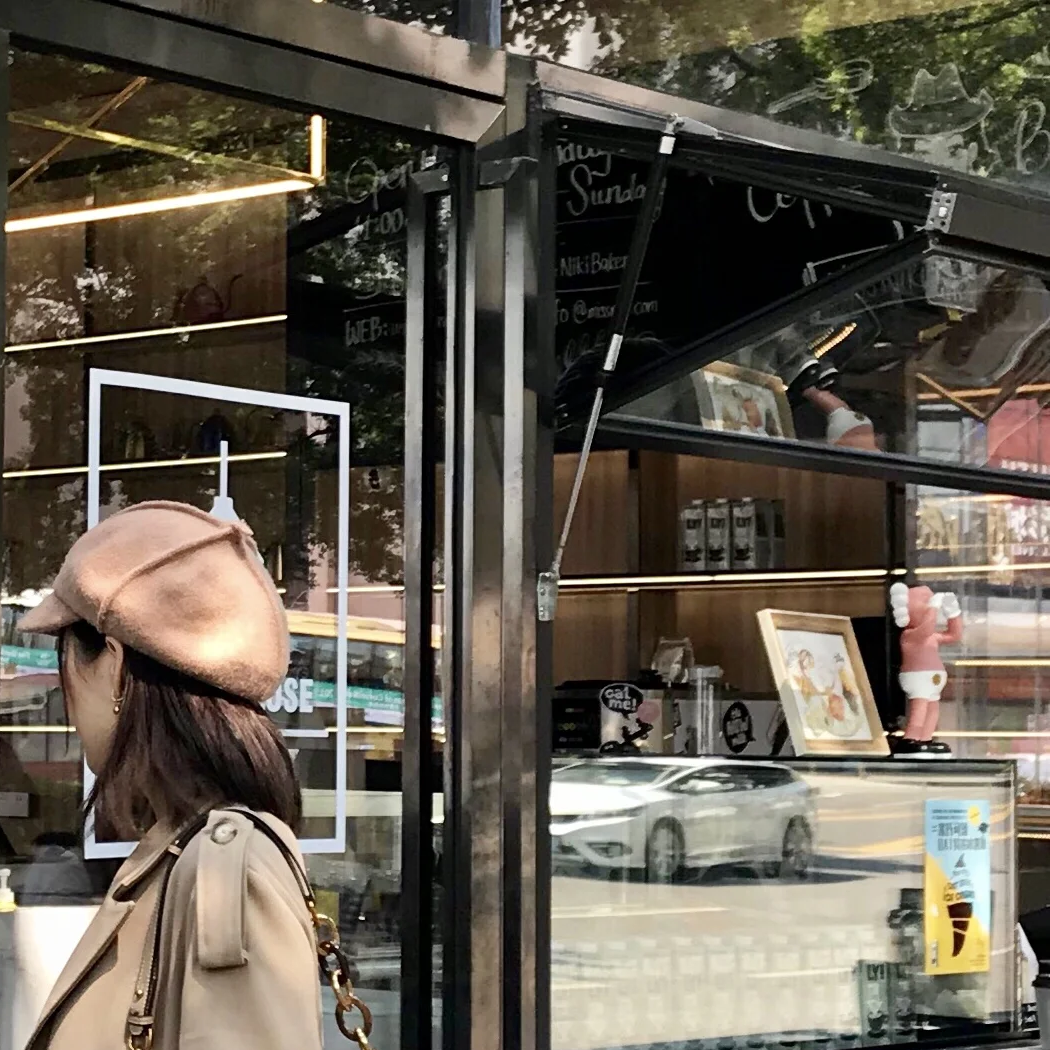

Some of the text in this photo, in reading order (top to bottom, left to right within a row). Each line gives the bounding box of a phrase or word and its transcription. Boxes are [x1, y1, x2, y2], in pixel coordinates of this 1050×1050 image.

[591, 251, 629, 275] Baker
[260, 678, 314, 713] USE
[608, 697, 637, 711] me!
